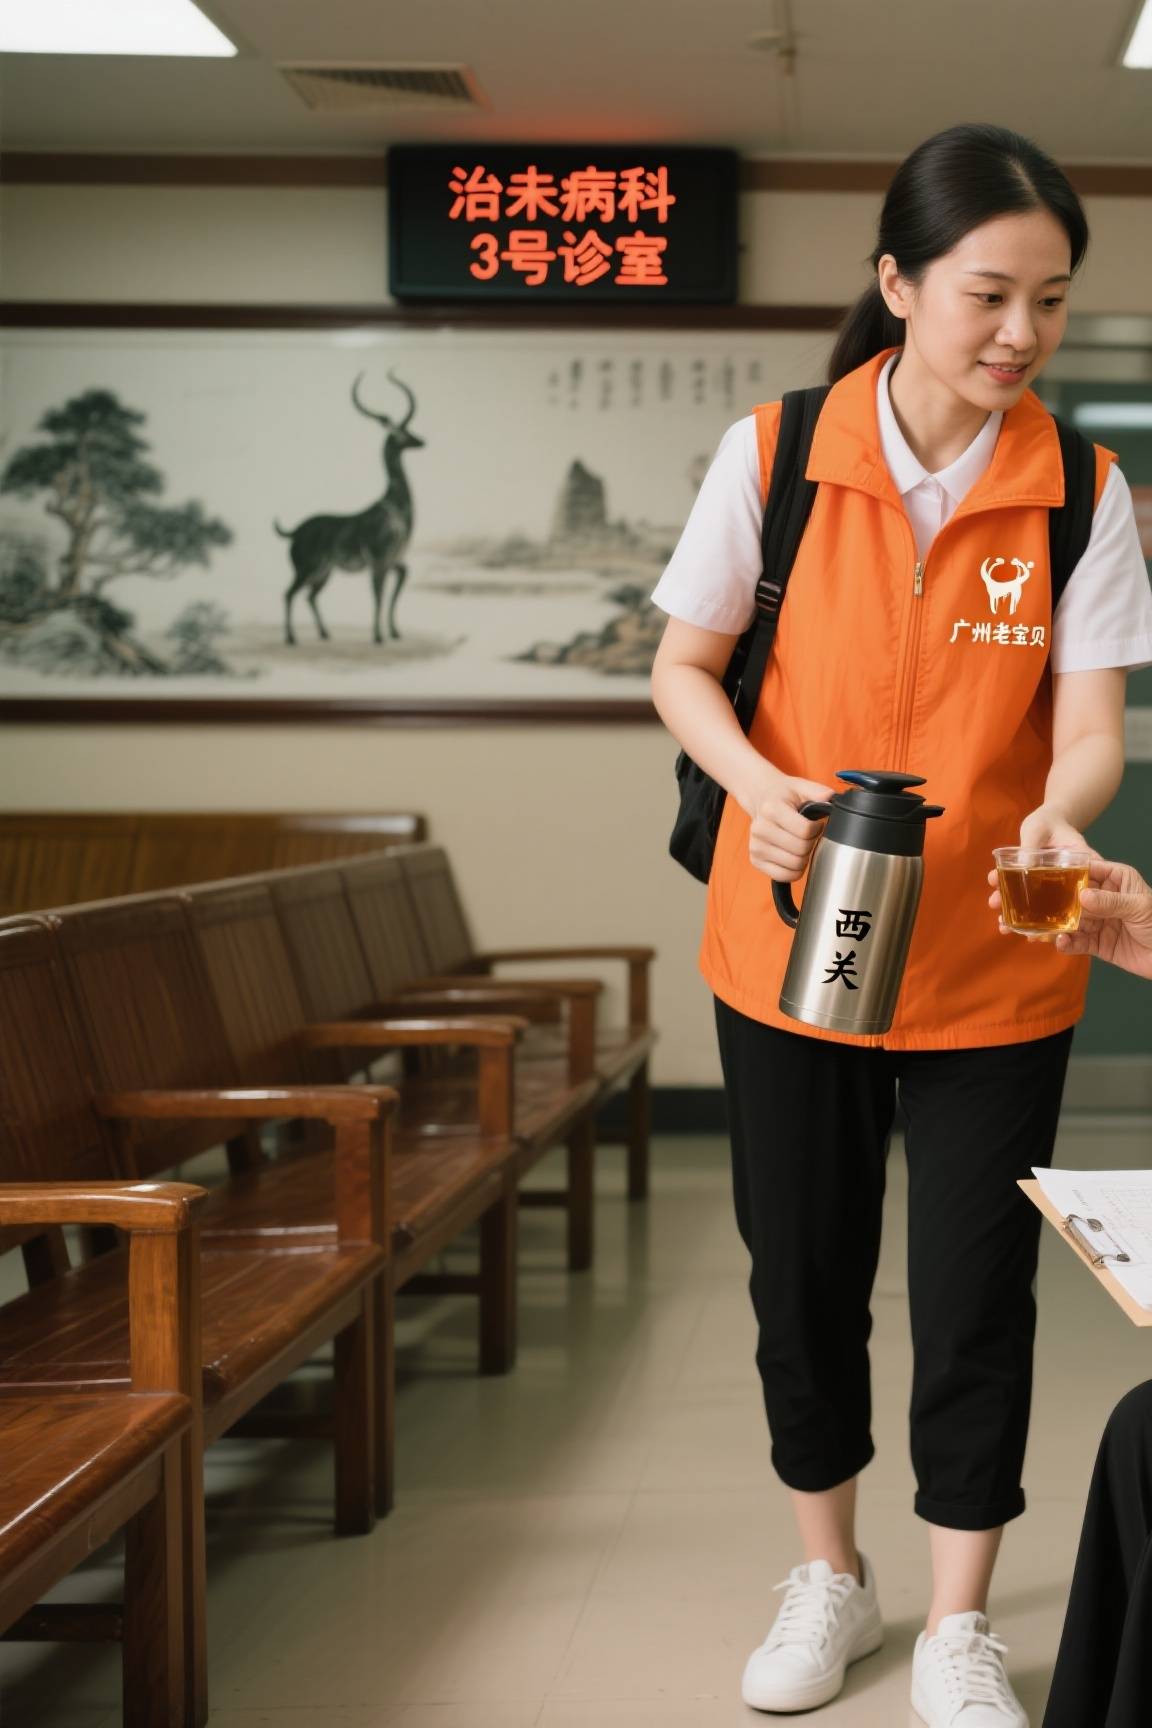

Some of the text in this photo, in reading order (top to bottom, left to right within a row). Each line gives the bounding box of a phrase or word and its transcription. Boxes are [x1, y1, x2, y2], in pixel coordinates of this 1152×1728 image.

[448, 165, 676, 223] 治未病科
[469, 229, 669, 286] 3号诊室
[949, 618, 1046, 648] 广州老宝贝
[821, 908, 873, 990] 西关
